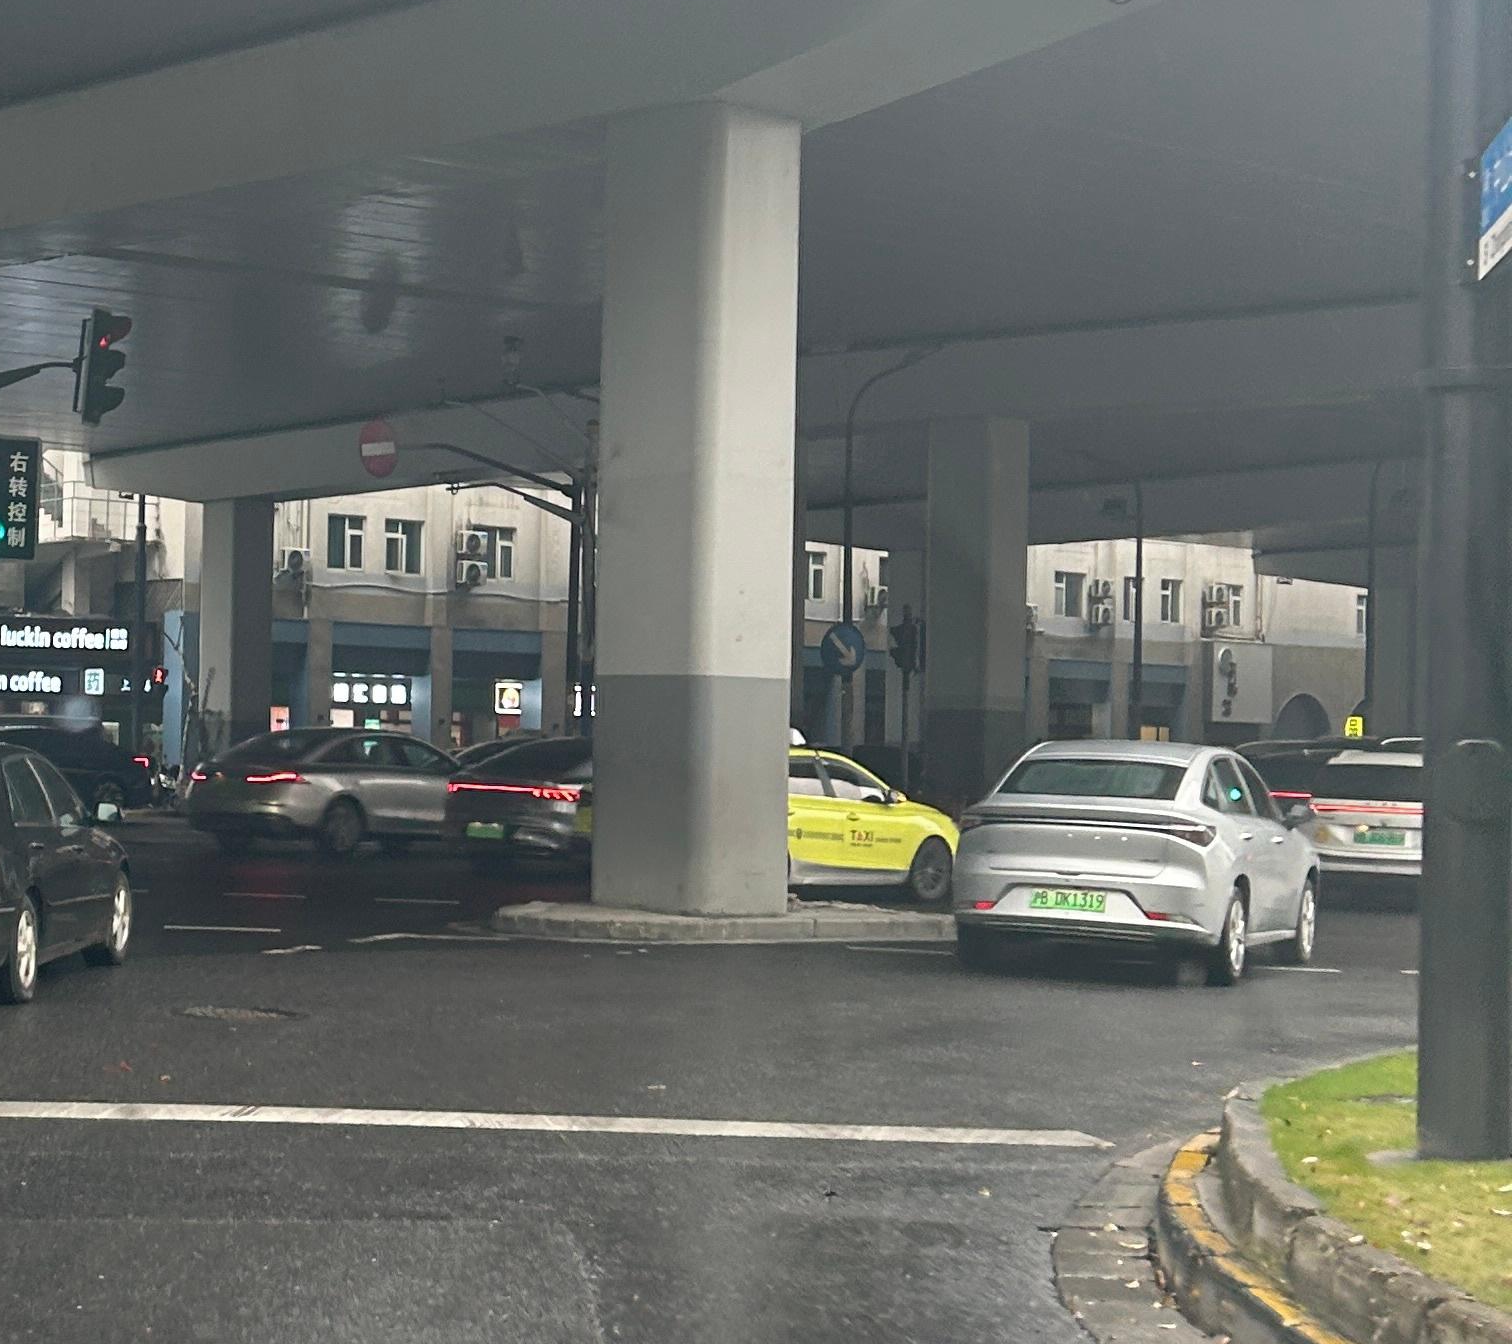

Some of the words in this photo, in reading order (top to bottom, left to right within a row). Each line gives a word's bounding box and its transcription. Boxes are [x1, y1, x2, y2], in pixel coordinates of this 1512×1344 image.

[7, 451, 29, 548] 右转控制
[0, 624, 51, 648] luckin
[52, 627, 105, 650] coffee
[9, 670, 62, 693] coffee
[850, 830, 874, 842] TAXI
